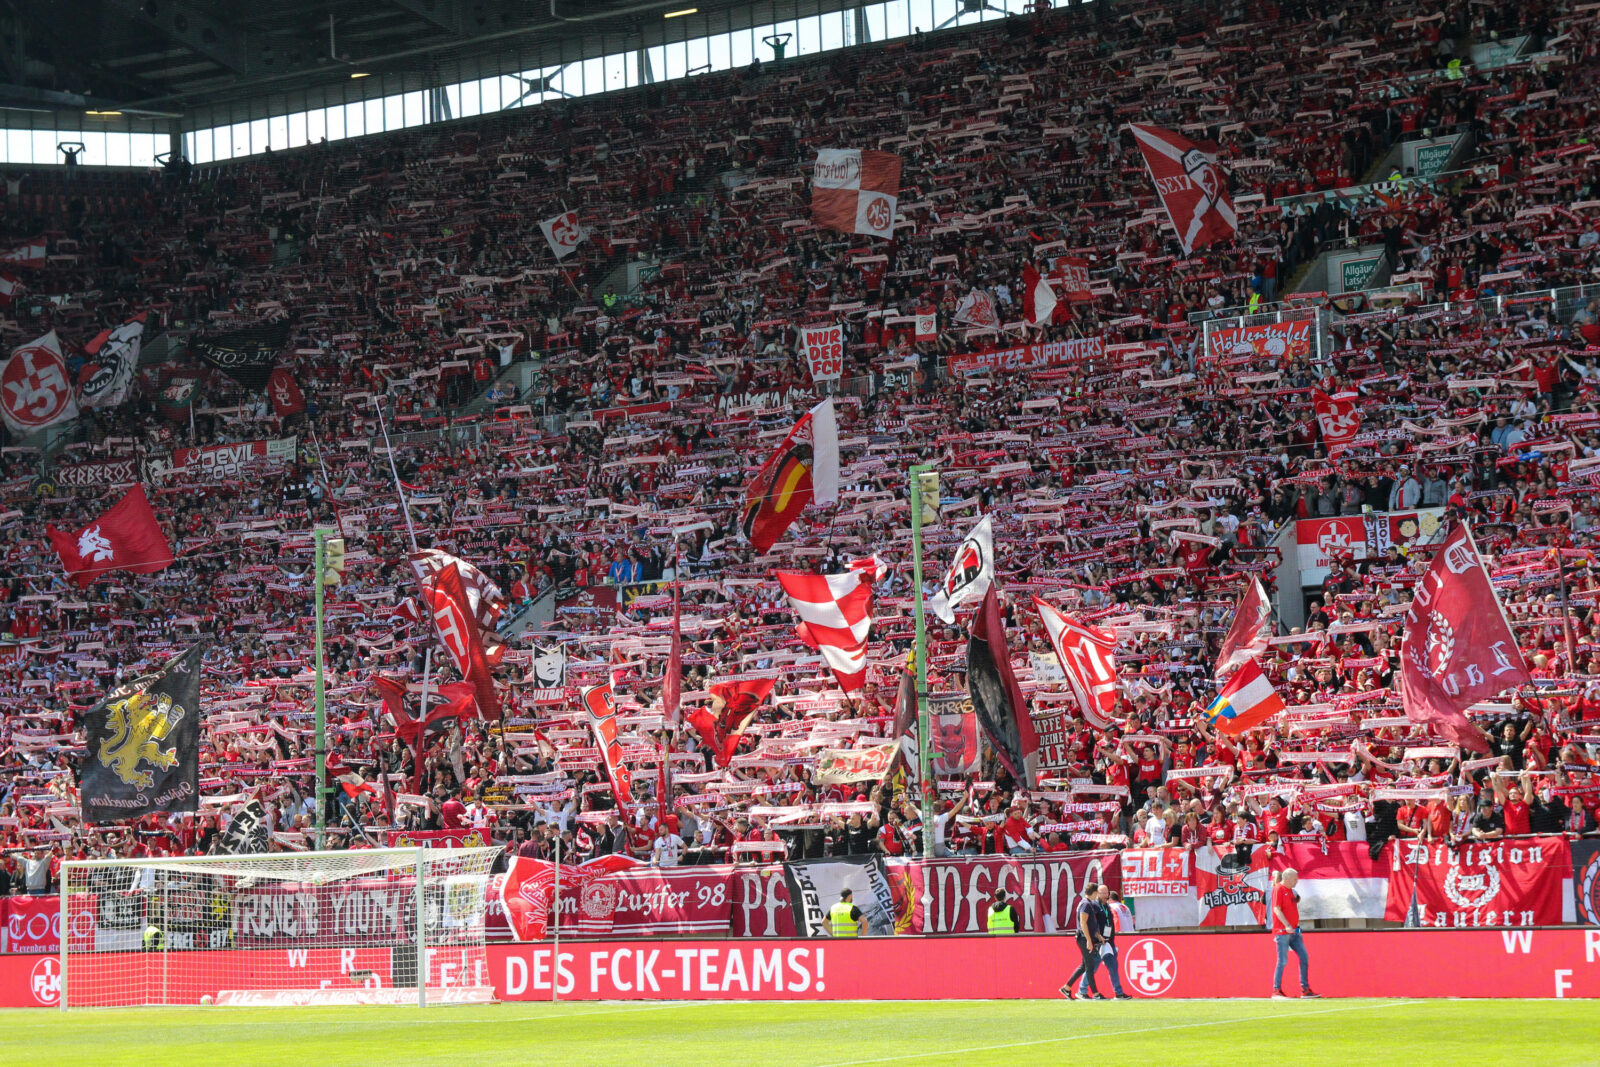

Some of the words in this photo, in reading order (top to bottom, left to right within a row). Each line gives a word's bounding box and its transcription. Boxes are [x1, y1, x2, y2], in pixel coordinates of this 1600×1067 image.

[807, 328, 840, 346] NUR
[809, 343, 841, 360] DER
[1031, 336, 1101, 364] SUPPORTERS
[812, 359, 841, 375] FCK
[58, 459, 136, 486] KERBEROS
[533, 688, 565, 701] ULTRAS
[1032, 716, 1062, 735] MPFE
[1039, 731, 1065, 747] DEINE
[1036, 744, 1067, 769] ELE
[1405, 842, 1543, 866] Division
[1122, 851, 1189, 879] 50+1
[615, 885, 690, 915] Luzifer
[695, 880, 726, 909] '98
[1123, 880, 1188, 895] ERHALTEN
[1204, 889, 1261, 908] Halunken
[330, 890, 400, 935] YOUTH
[506, 948, 575, 996] DES
[590, 946, 826, 994] FCK-TEAMS!
